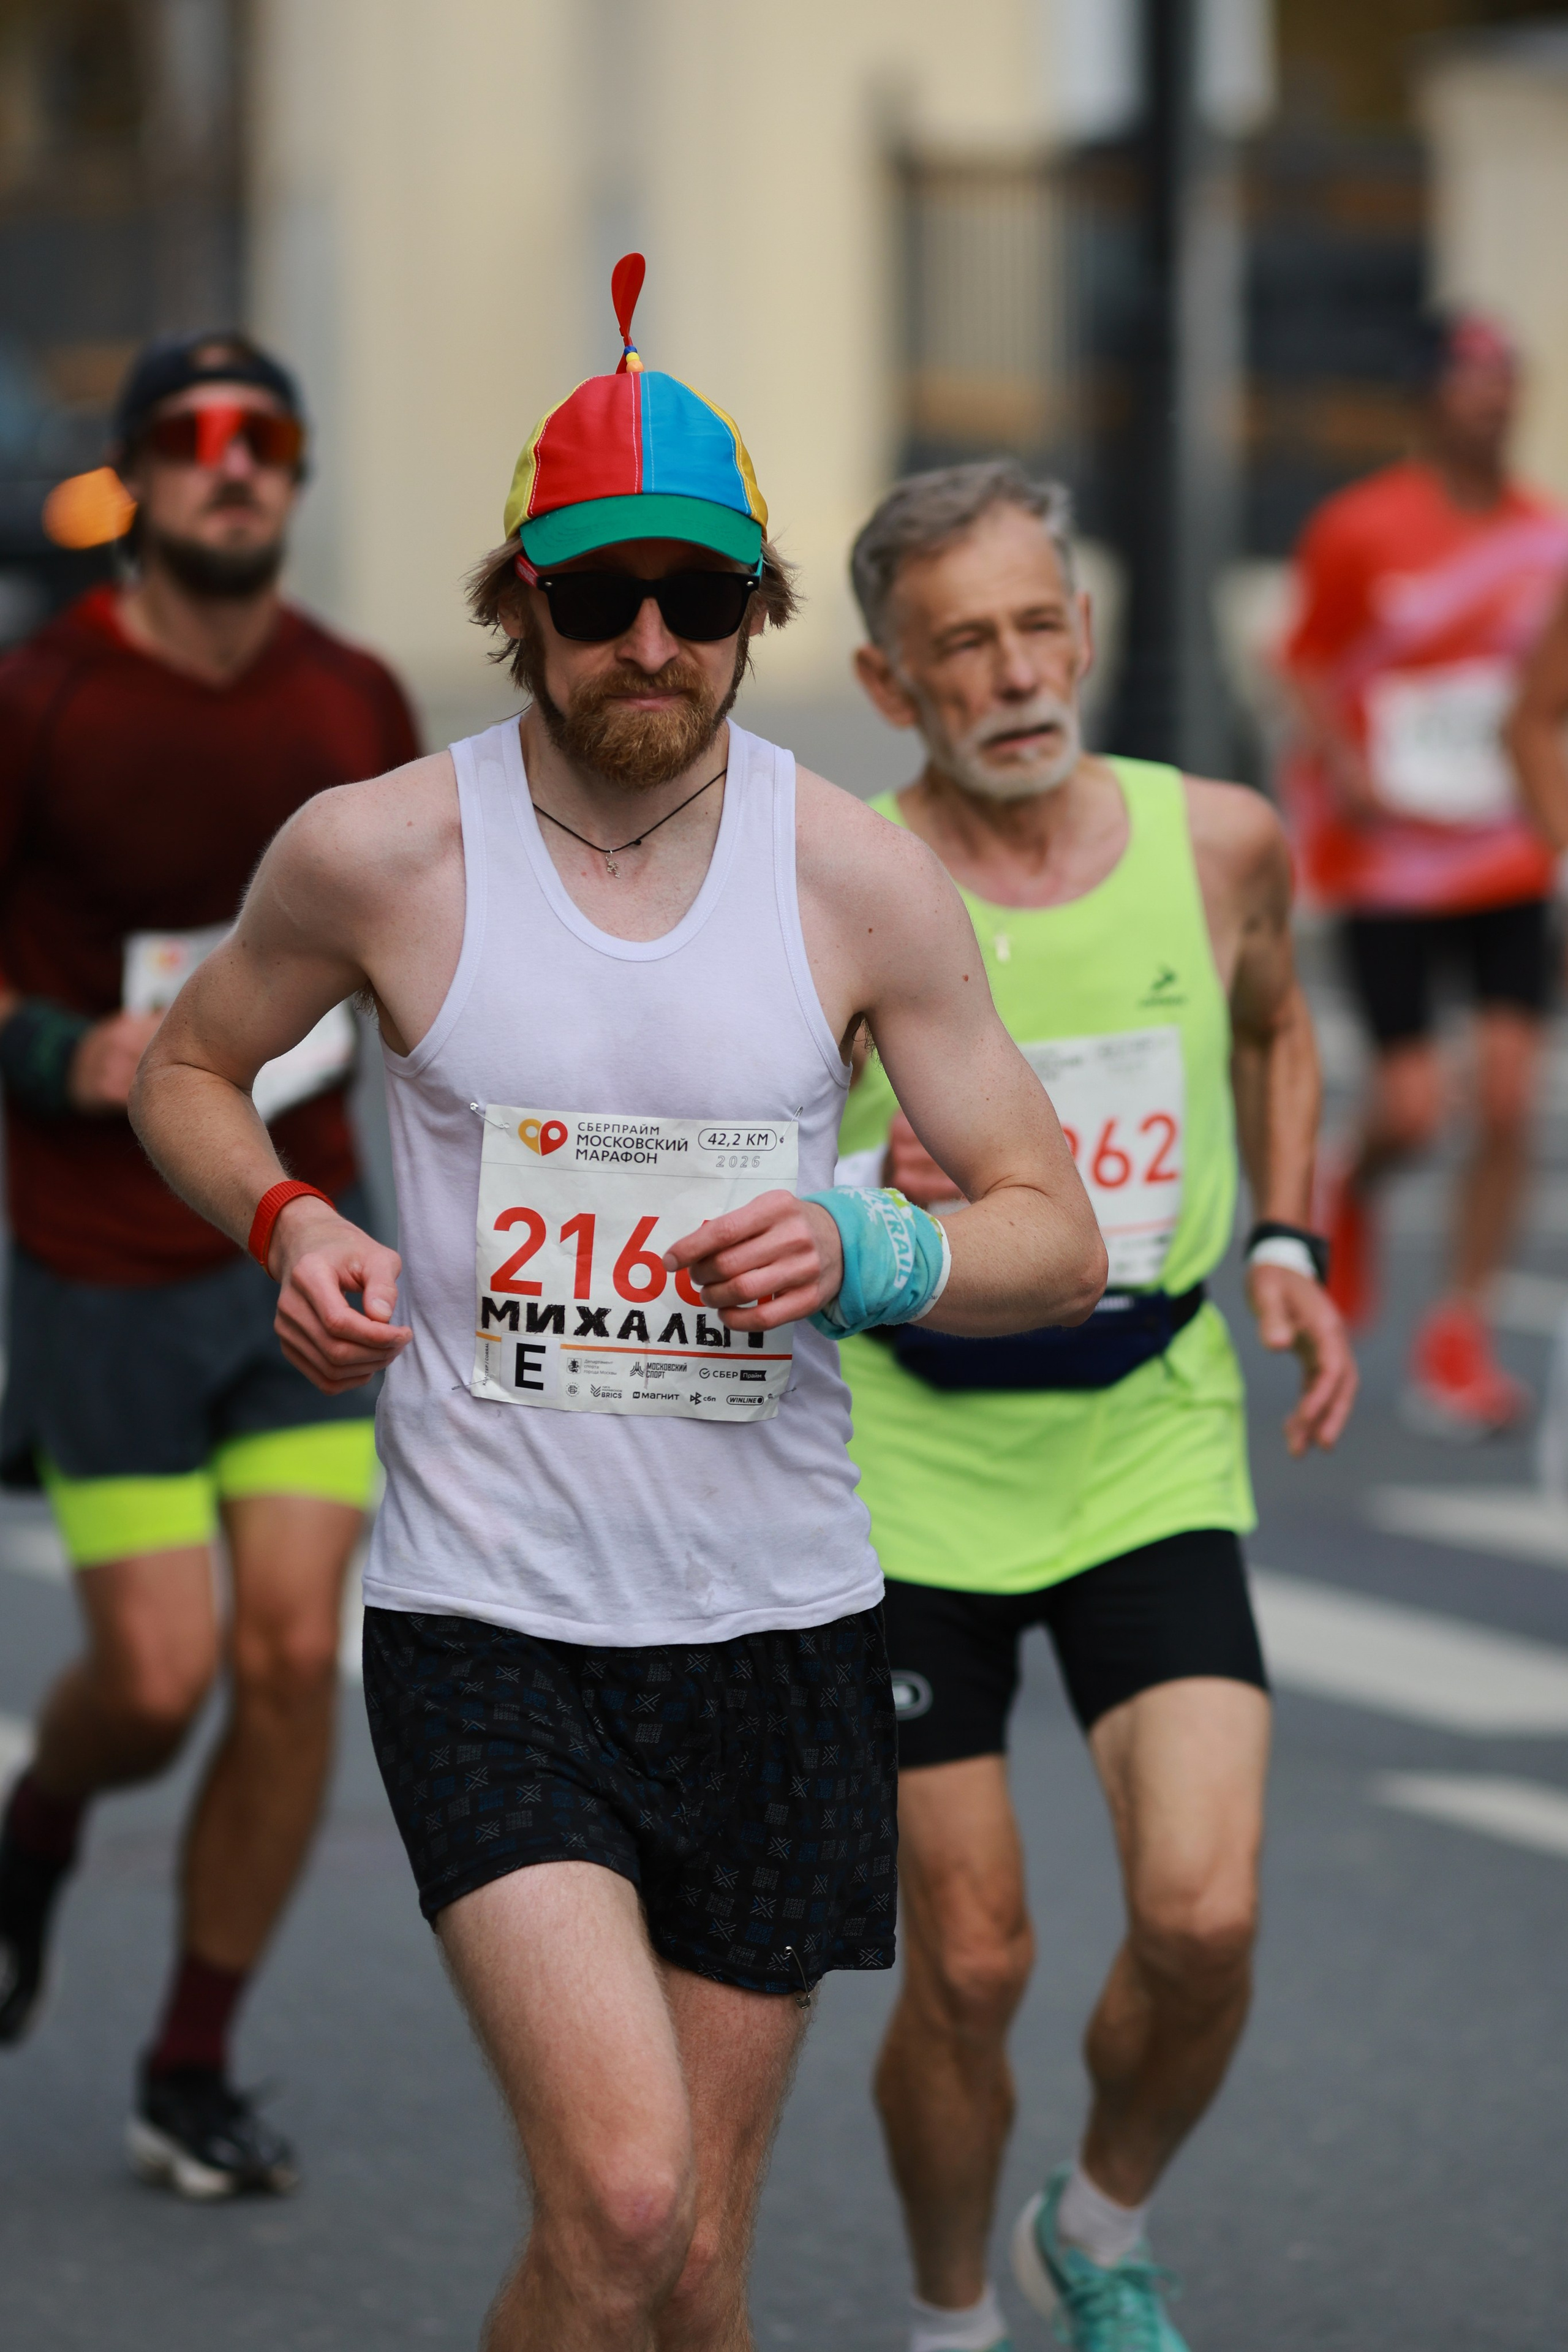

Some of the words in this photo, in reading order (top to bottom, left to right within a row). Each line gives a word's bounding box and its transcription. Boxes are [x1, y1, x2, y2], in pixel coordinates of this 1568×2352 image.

[578, 1121, 660, 1135] СБЕРПРАЙМ
[576, 1134, 688, 1152] МОСКОВСКИЙ
[707, 1133, 741, 1147] 42,2
[746, 1134, 769, 1146] КМ
[575, 1149, 657, 1164] МАРАФОН
[715, 1155, 760, 1168] 2026
[884, 1208, 911, 1282] TRAIL
[647, 1363, 687, 1372] МОСКОВСКИЙ
[646, 1370, 665, 1379] СПОРТ
[712, 1370, 738, 1379] СБЕР
[641, 1392, 680, 1401] магнит
